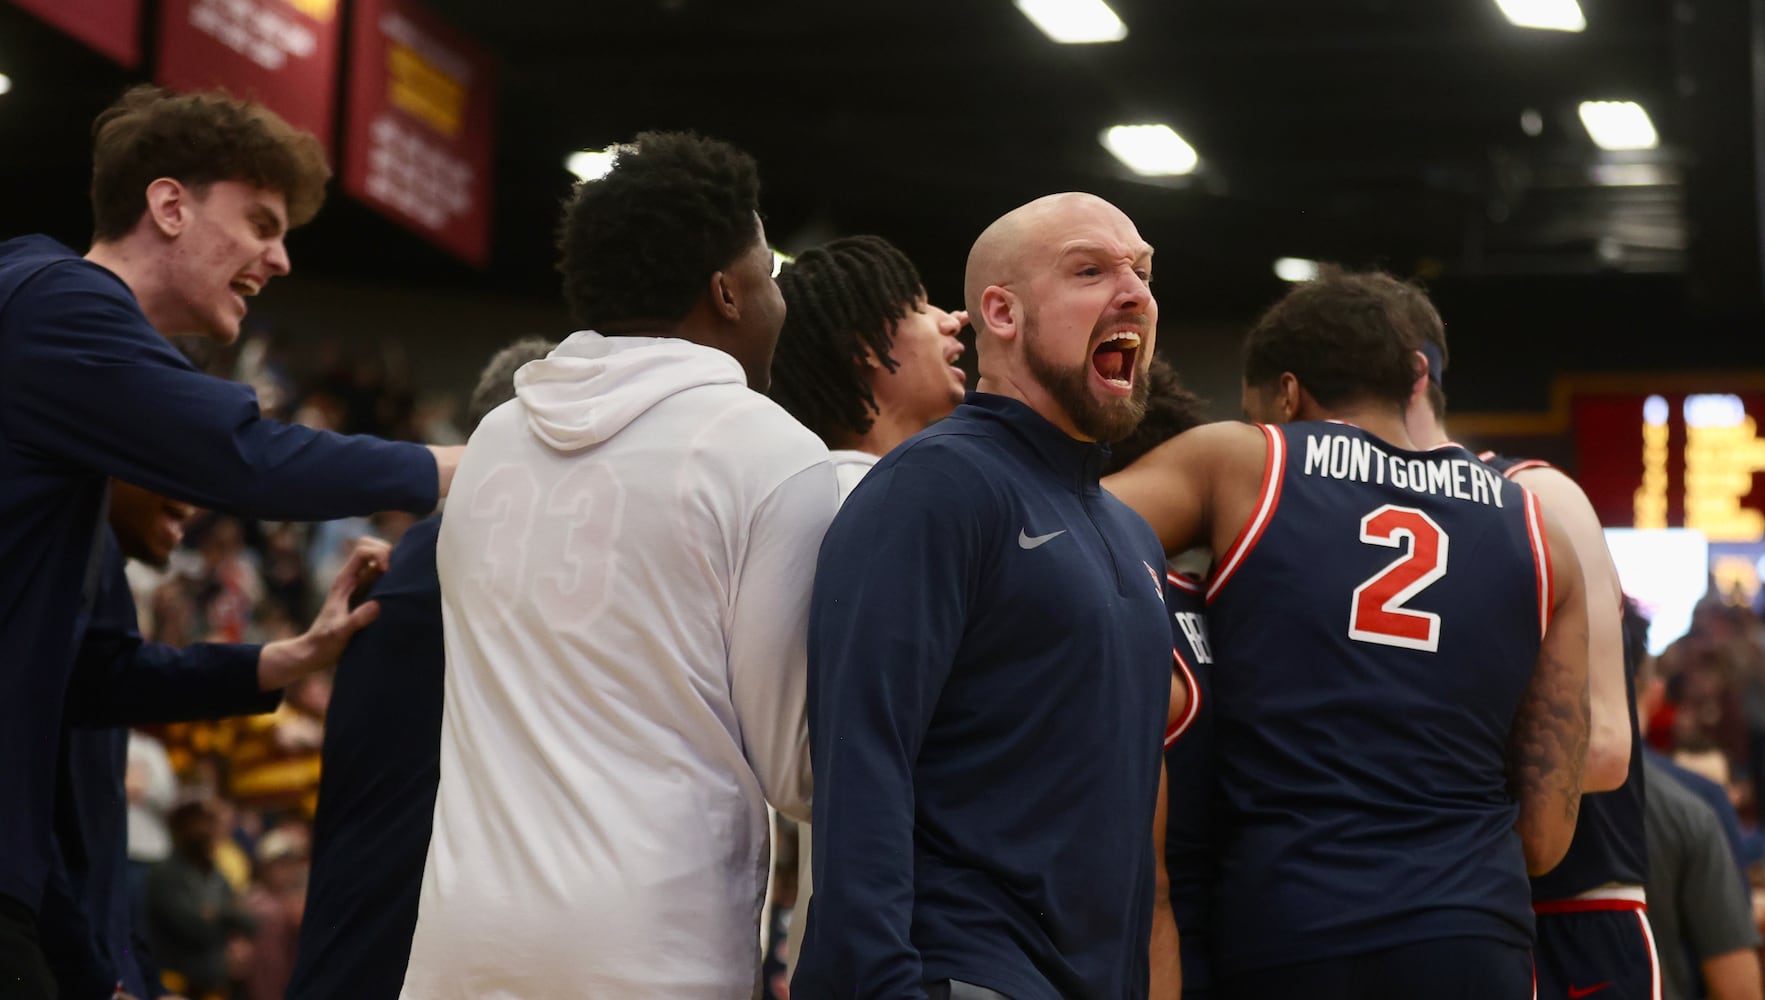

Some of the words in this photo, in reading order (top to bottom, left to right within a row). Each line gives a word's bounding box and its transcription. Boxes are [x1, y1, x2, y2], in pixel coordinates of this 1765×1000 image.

[1304, 434, 1504, 508] MONTGOMERY
[461, 460, 627, 634] 33
[1348, 503, 1450, 653] 2
